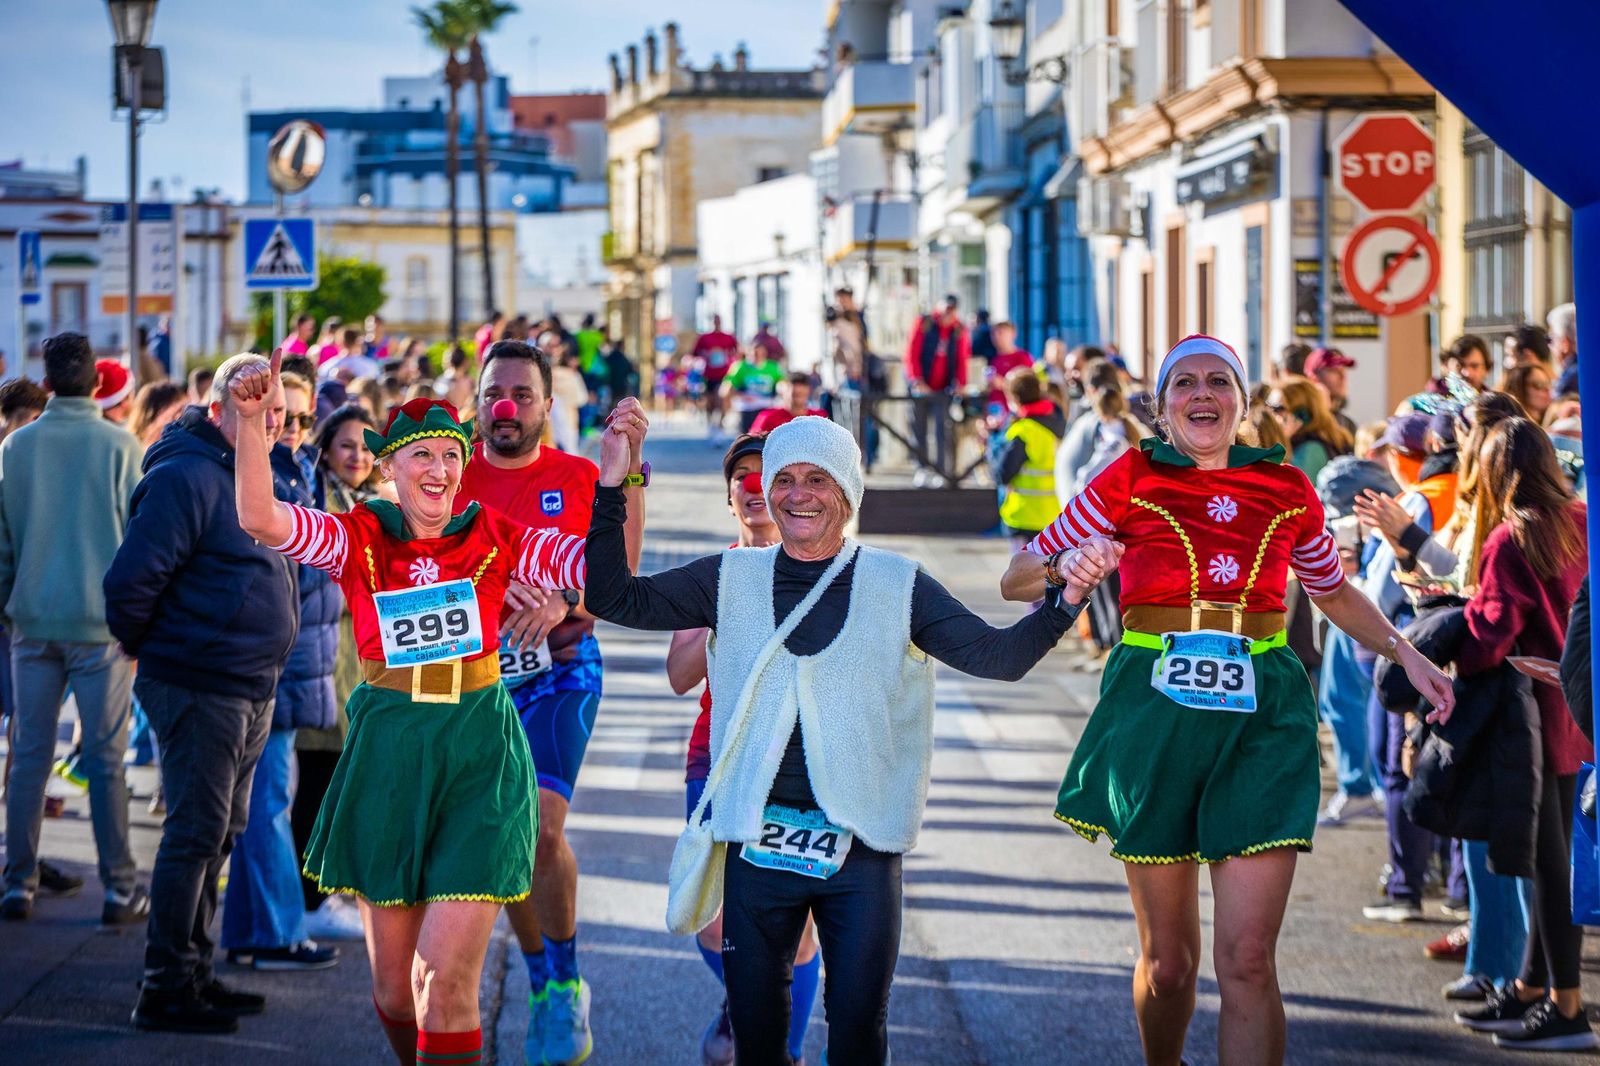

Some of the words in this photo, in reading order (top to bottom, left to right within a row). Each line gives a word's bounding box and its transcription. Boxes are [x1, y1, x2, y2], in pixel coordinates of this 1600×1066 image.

[1342, 150, 1434, 178] STOP
[393, 608, 470, 647] 299
[415, 648, 450, 661] cajasur
[1168, 657, 1244, 691] 293
[1184, 695, 1218, 705] cajasur
[759, 823, 838, 859] 244
[772, 858, 806, 870] cajasur
